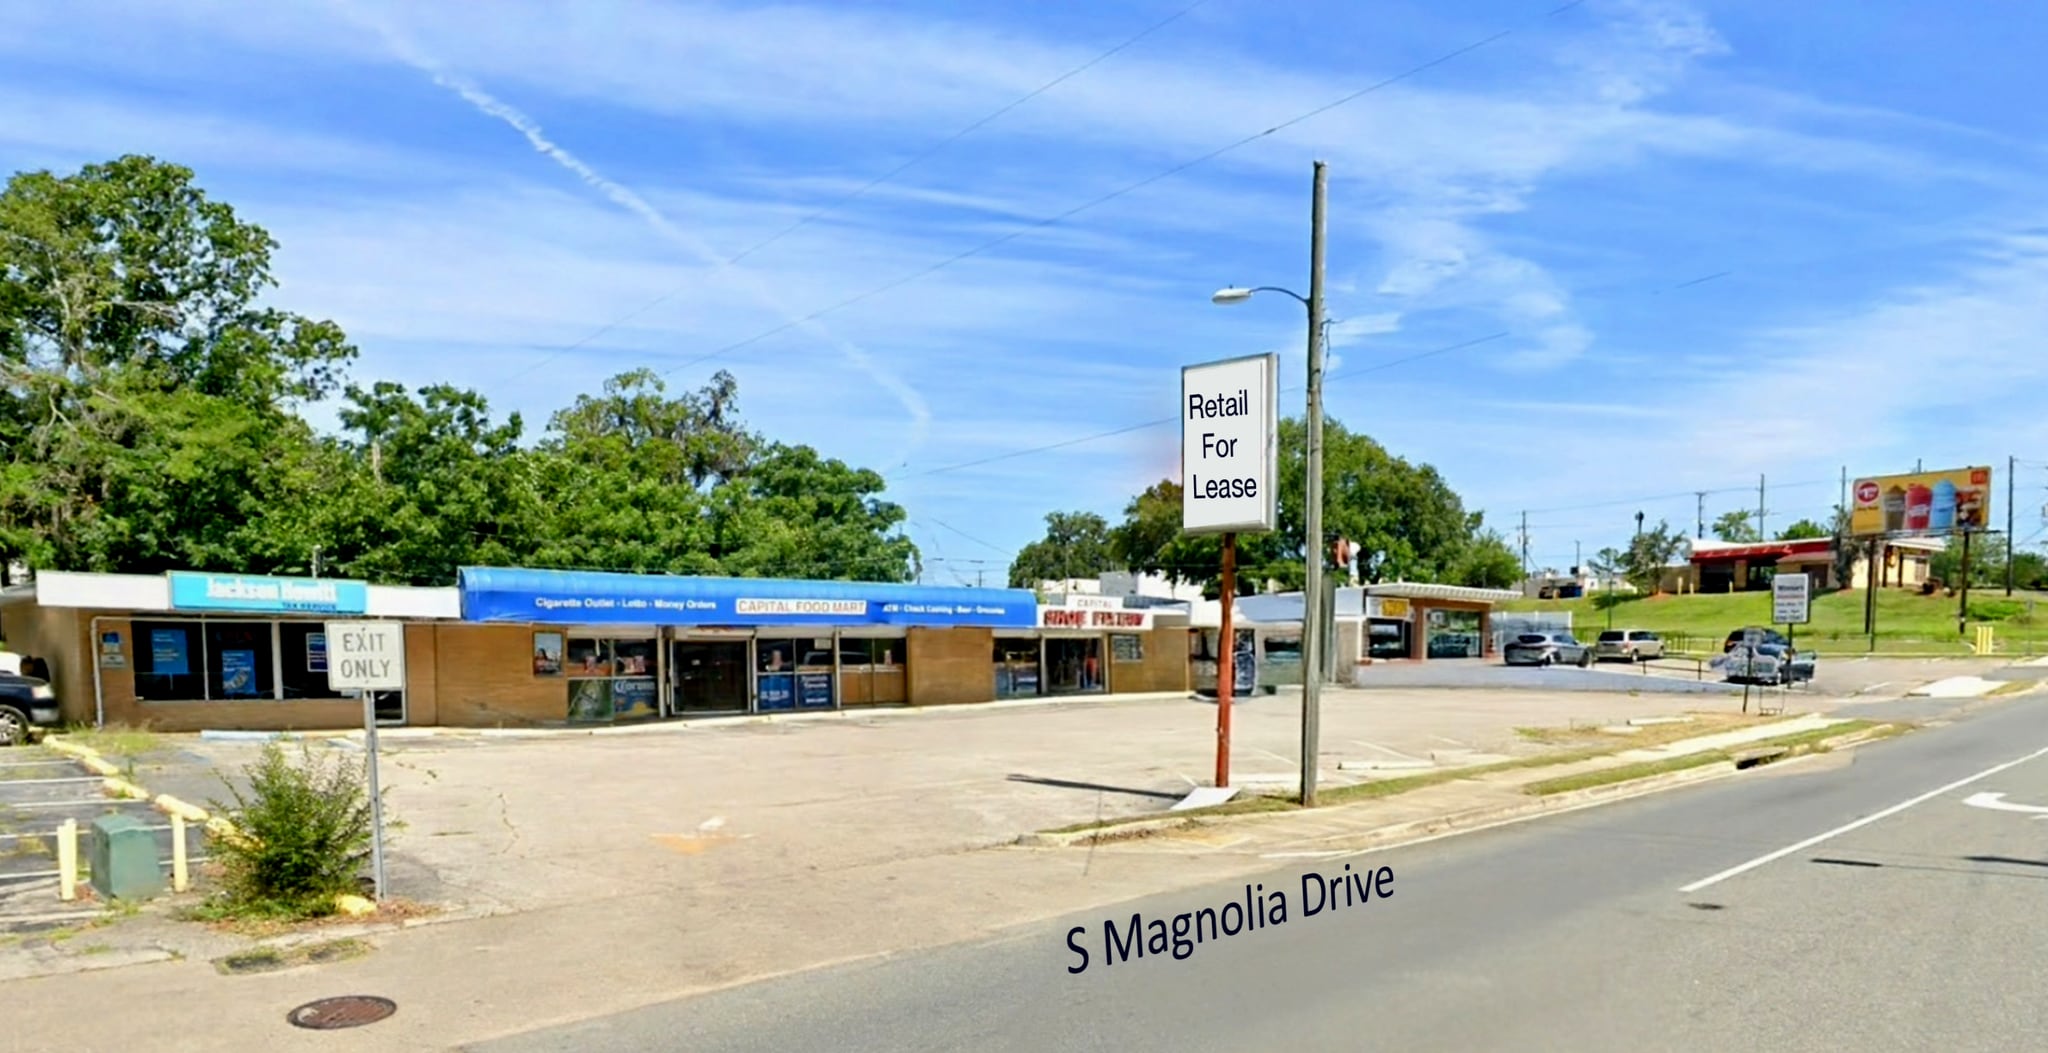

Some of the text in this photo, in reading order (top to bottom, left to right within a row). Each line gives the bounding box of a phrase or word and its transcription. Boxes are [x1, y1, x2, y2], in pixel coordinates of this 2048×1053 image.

[1189, 388, 1248, 419] Retail
[1202, 433, 1238, 459] For
[1193, 474, 1257, 499] Lease
[535, 597, 717, 611] Cigarette Outlet Lotto Money Orders
[738, 600, 866, 614] CAPITAL FOOD MART
[1077, 600, 1112, 609] CAPITAL
[342, 632, 385, 652] EXIT
[340, 659, 392, 679] ONLY
